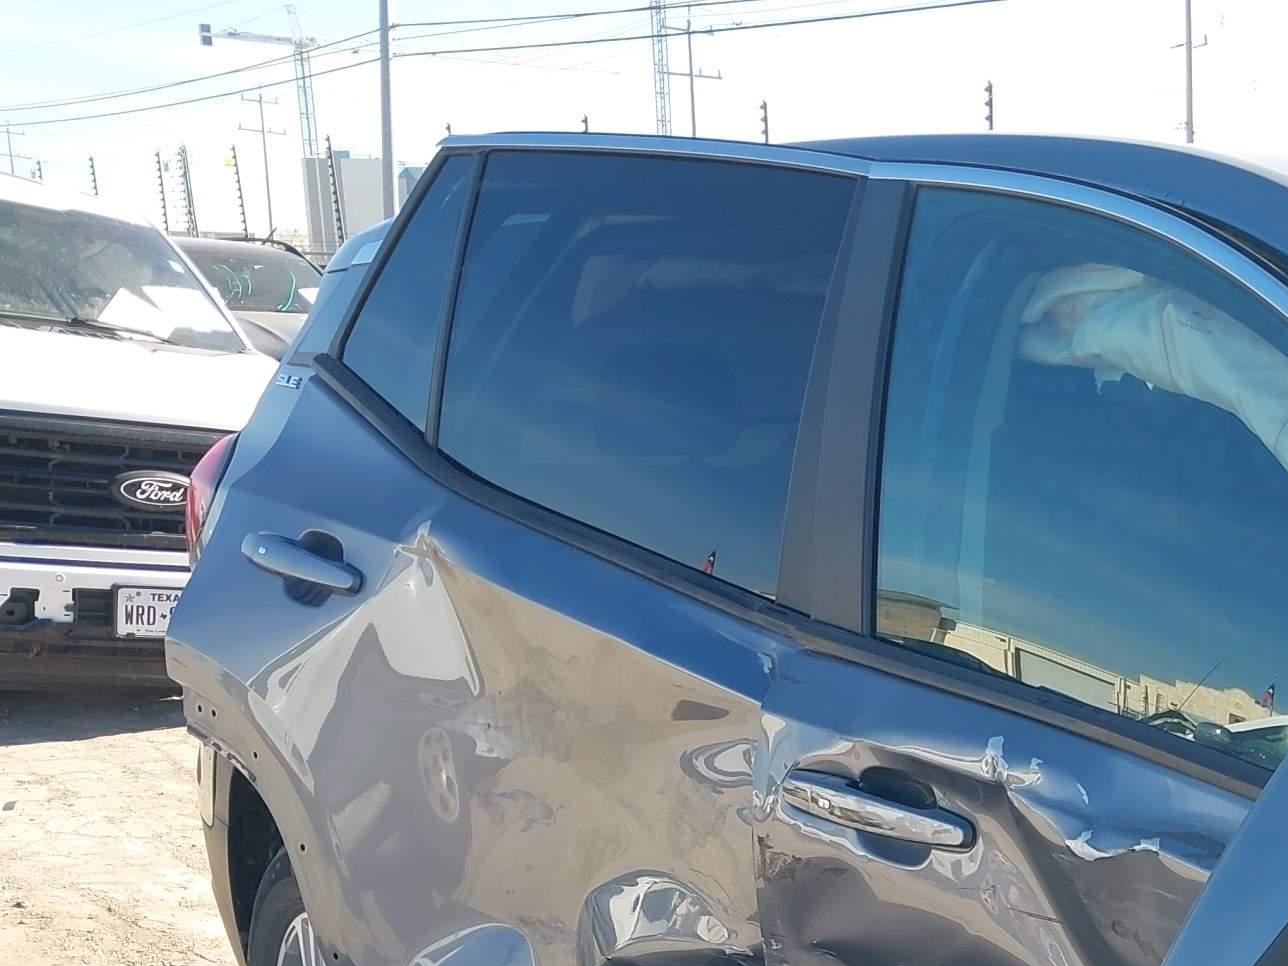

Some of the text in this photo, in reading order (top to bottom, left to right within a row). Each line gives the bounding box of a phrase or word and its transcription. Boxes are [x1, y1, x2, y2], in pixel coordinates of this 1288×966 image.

[275, 375, 303, 389] SLE
[135, 480, 185, 502] Ford
[150, 592, 181, 603] TEXA
[124, 604, 157, 626] WRD
